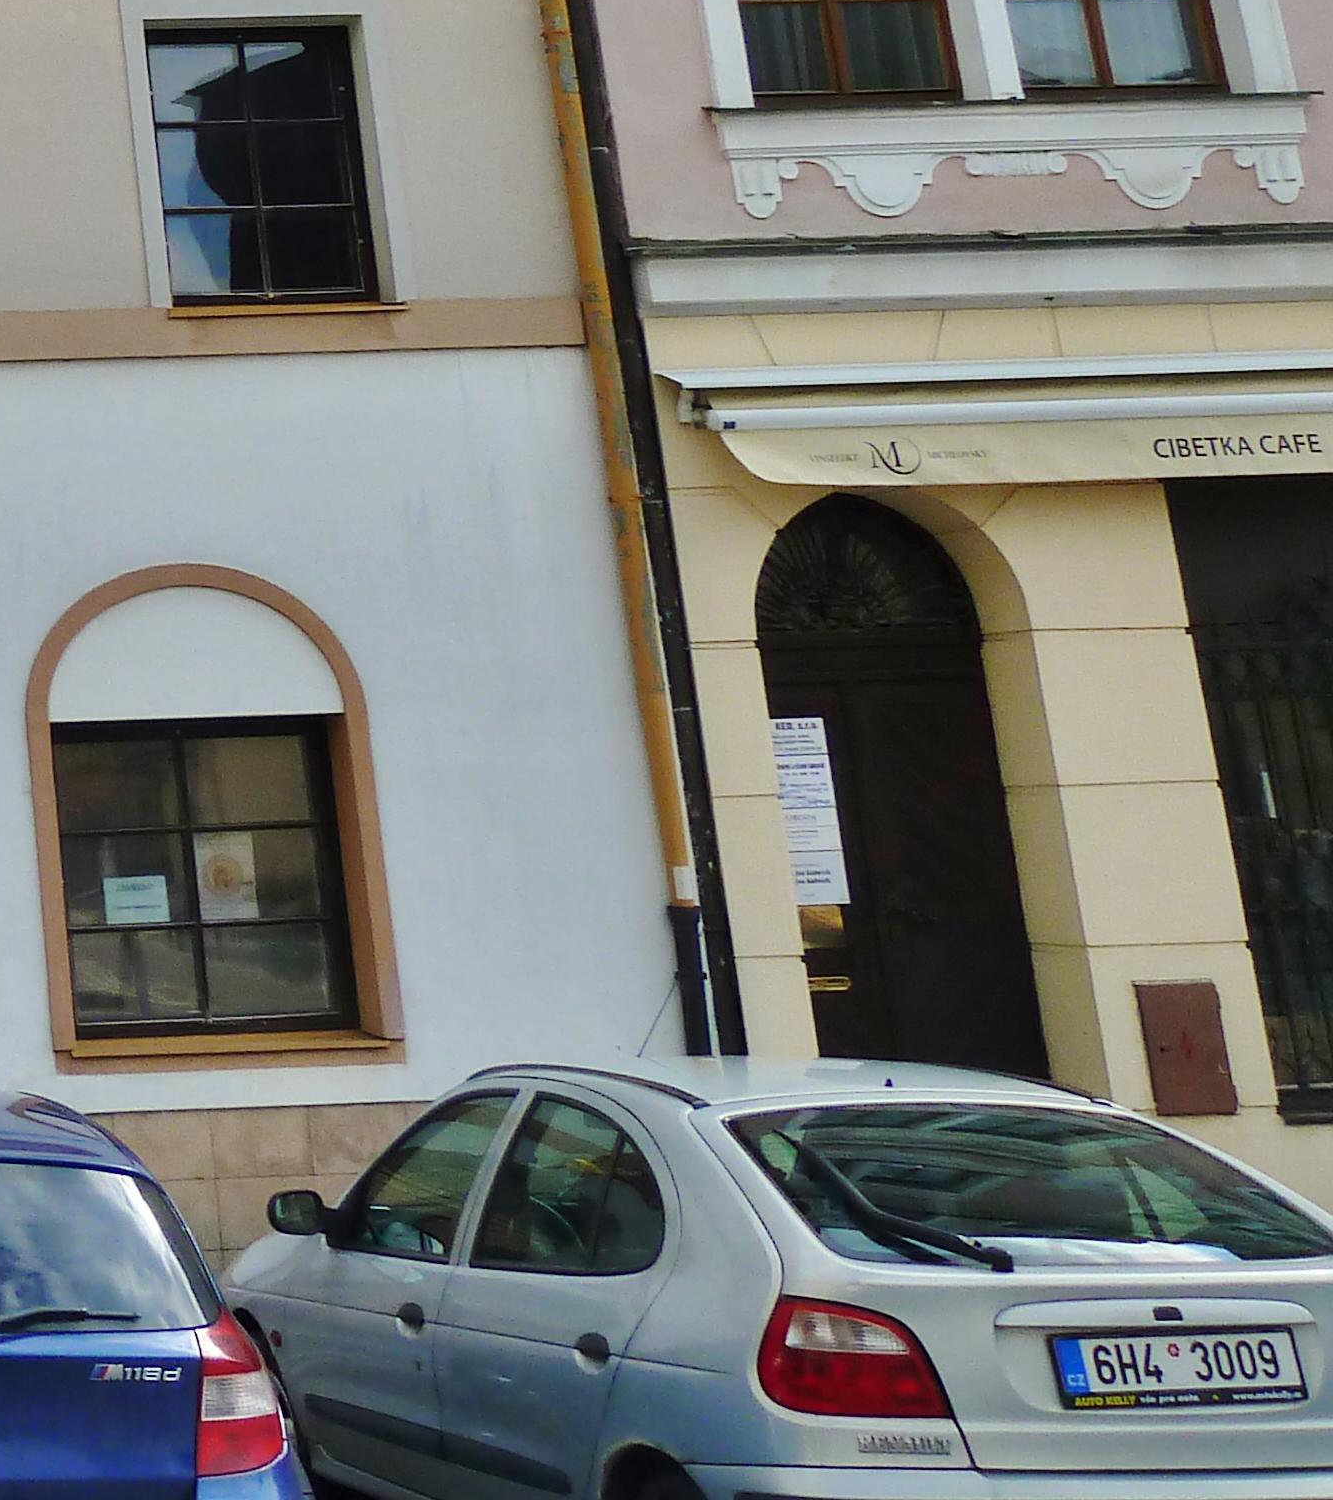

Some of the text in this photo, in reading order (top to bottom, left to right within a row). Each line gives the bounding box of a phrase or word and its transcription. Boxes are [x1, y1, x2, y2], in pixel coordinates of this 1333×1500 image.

[1153, 434, 1323, 459] CIBETKA CAFE
[1092, 1339, 1281, 1385] 6H4 3009
[1067, 1374, 1087, 1387] CZ
[1074, 1395, 1104, 1407] AUTO
